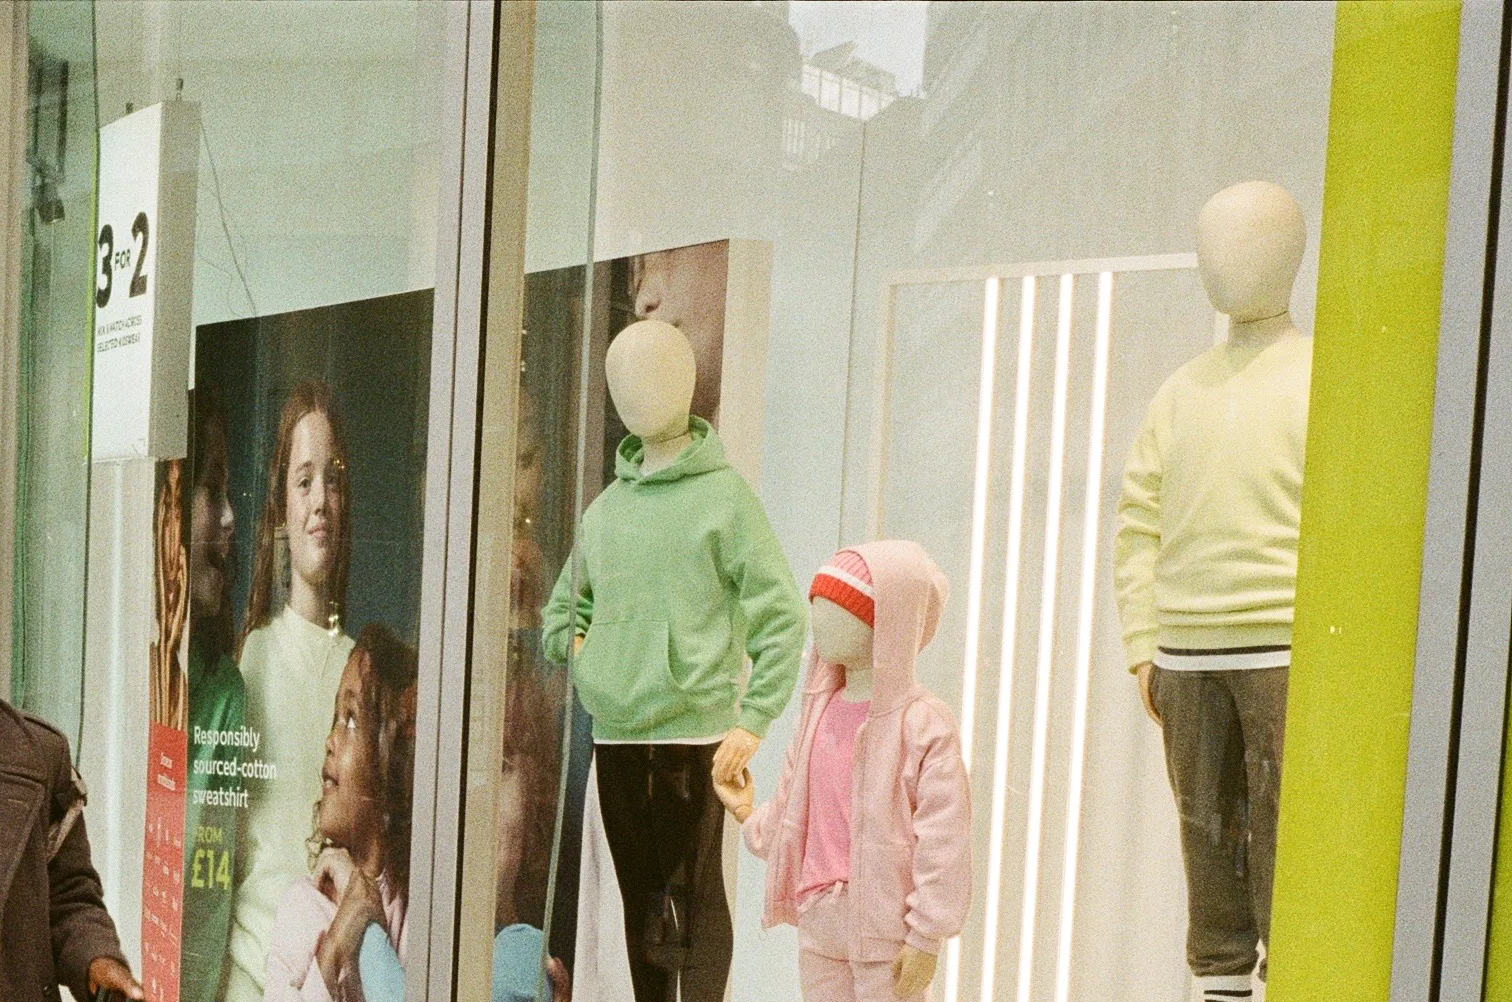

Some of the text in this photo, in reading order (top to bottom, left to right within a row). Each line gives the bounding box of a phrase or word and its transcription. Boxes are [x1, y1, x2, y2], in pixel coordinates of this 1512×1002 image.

[96, 211, 149, 308] 3 FOR 2
[193, 726, 261, 752] Responsibly
[193, 757, 277, 780] sourced-cotton
[193, 787, 249, 808] sweatshirt
[191, 849, 231, 890] £14
